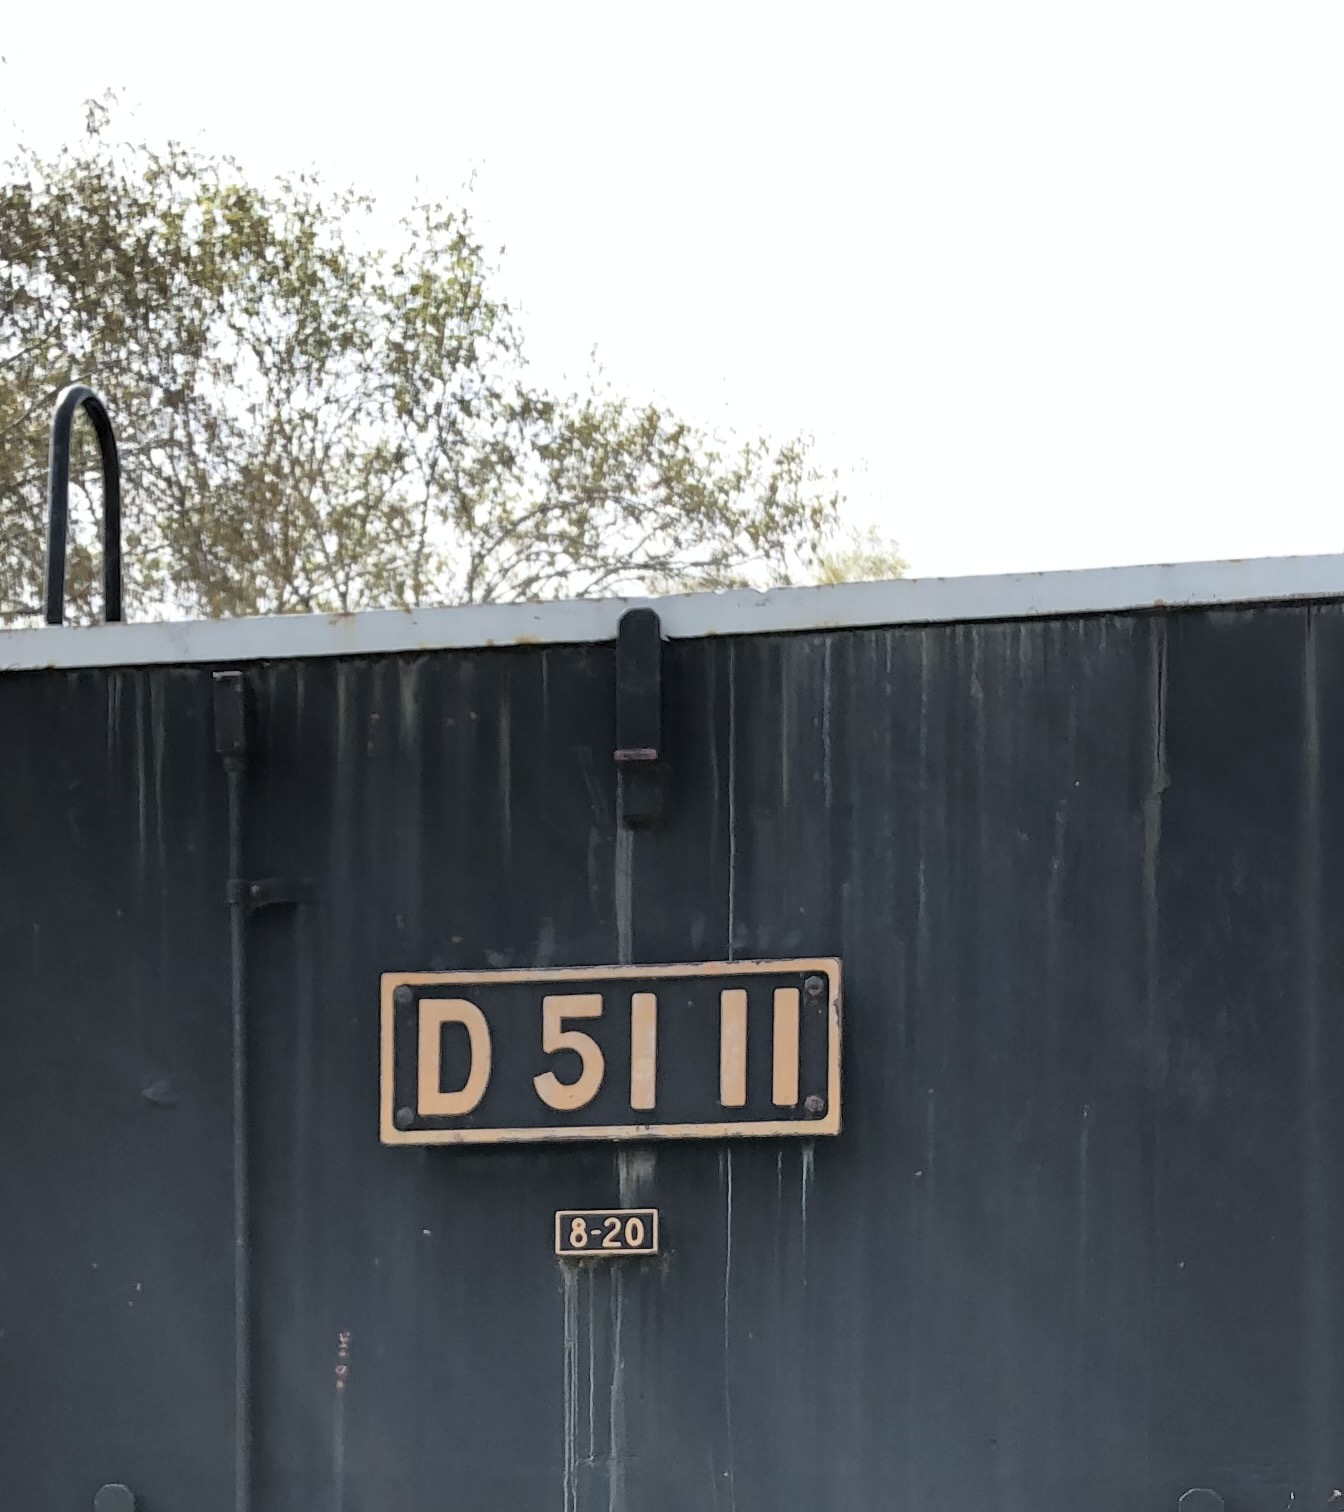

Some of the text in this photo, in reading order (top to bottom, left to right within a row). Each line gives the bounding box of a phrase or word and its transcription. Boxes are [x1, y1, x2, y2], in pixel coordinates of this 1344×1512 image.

[417, 987, 800, 1116] D 51 11
[568, 1217, 645, 1248] 8-20
